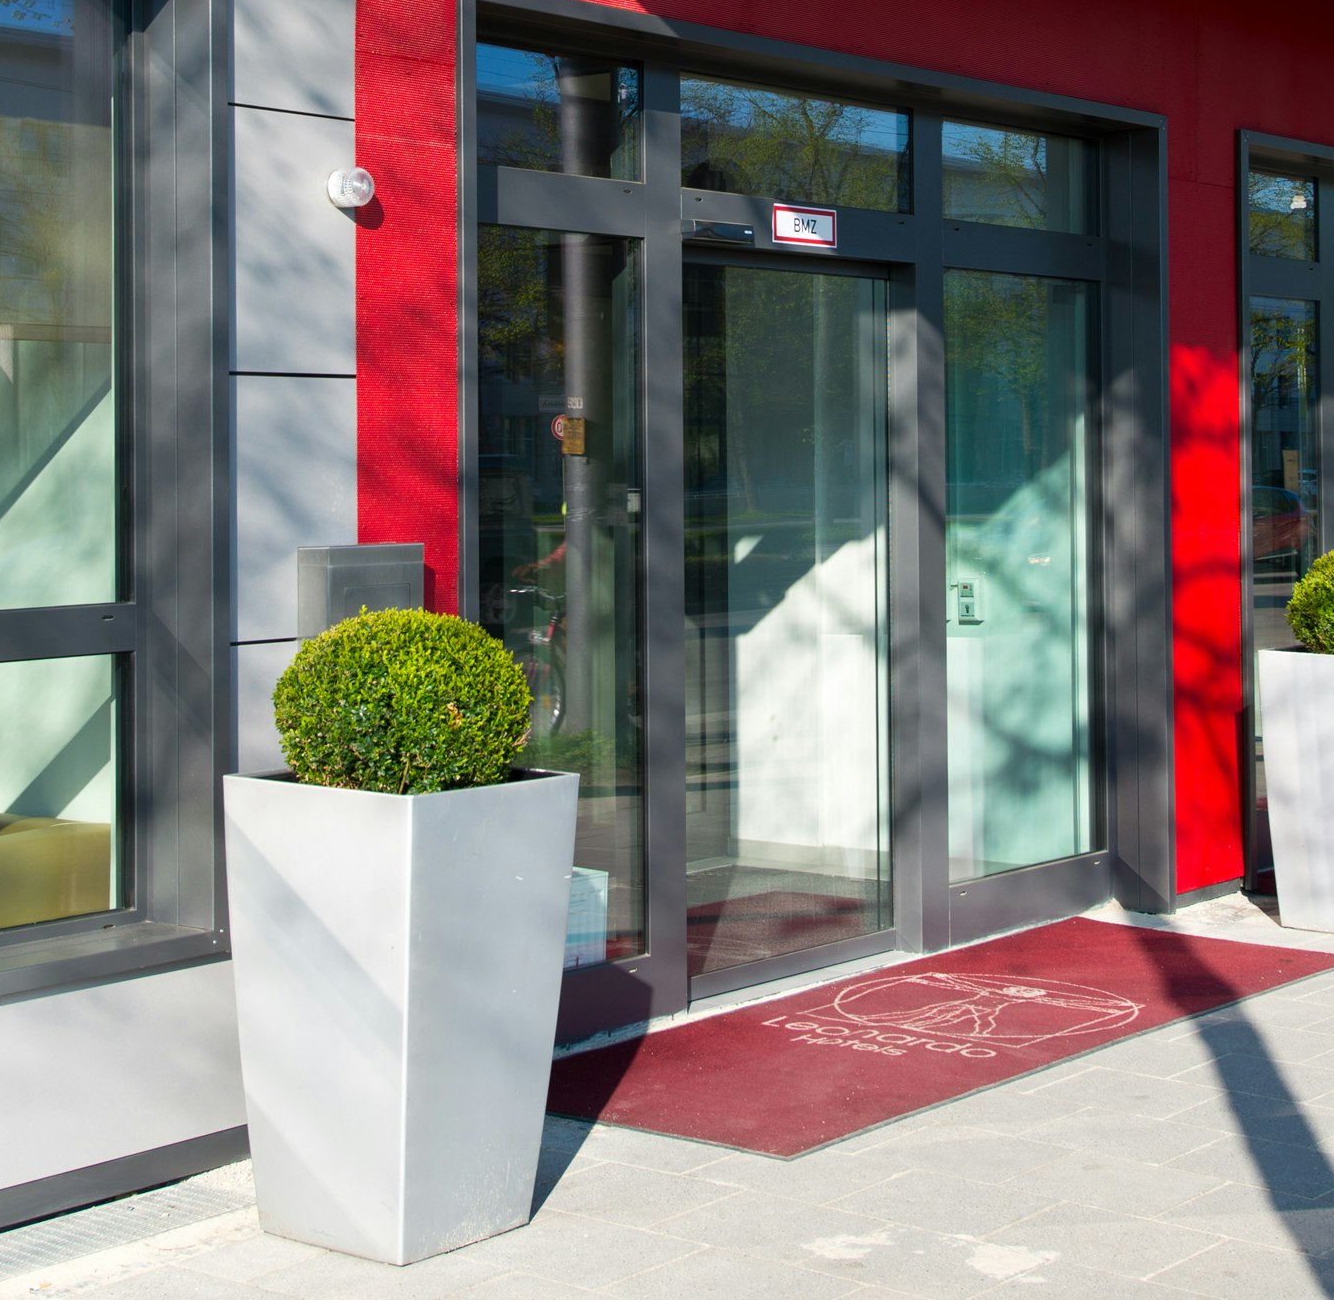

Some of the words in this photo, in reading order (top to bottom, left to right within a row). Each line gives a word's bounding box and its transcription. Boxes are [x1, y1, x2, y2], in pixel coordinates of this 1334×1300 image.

[793, 216, 818, 236] BMZ
[761, 1014, 997, 1058] Leonardo
[790, 1033, 910, 1057] Hotels
